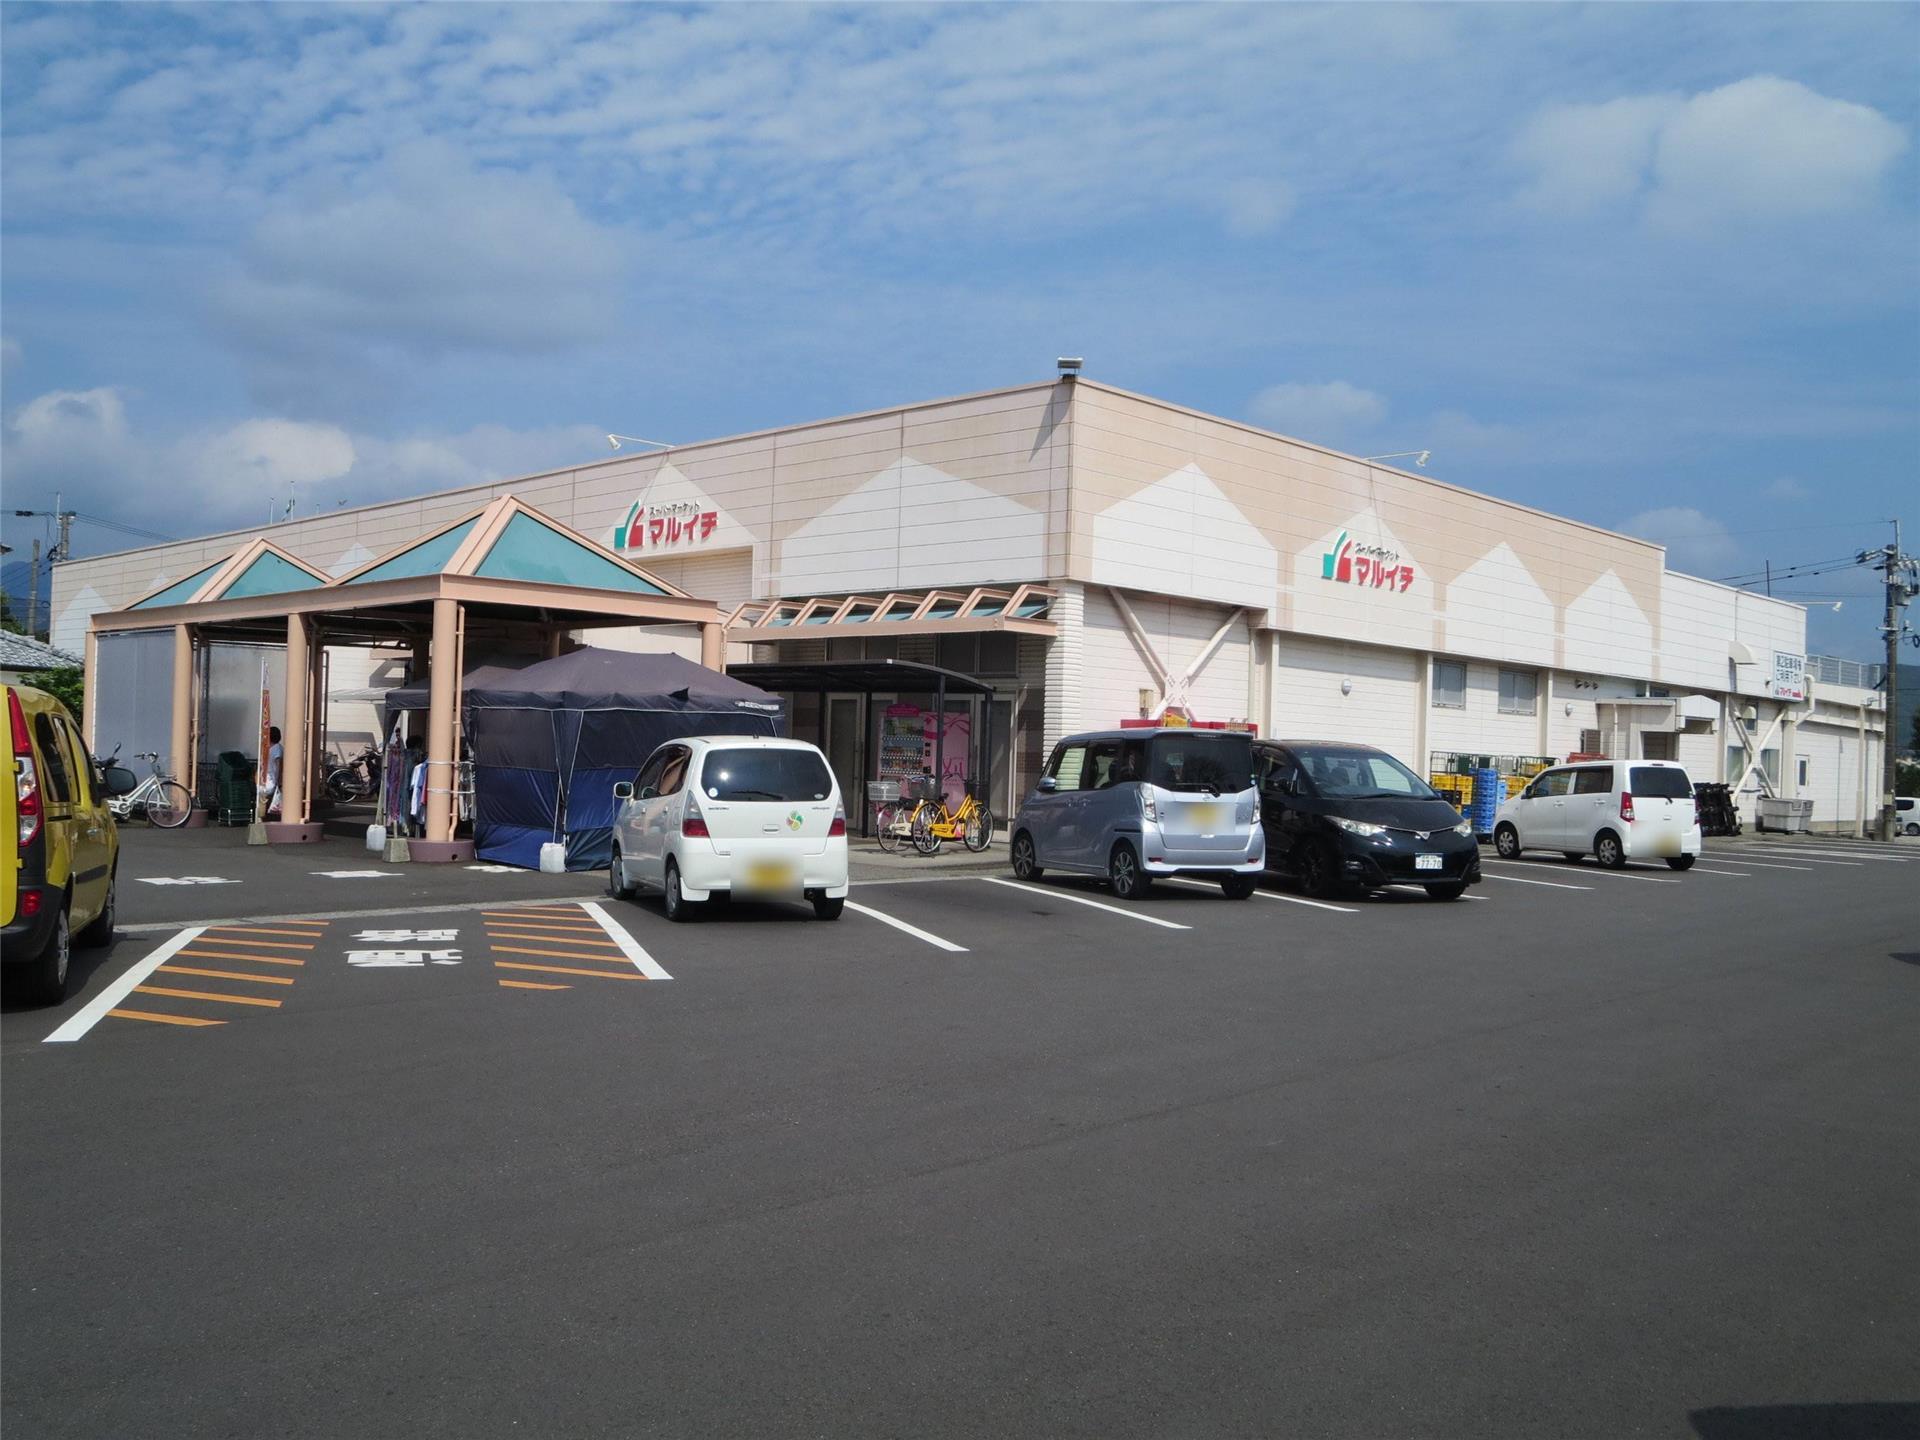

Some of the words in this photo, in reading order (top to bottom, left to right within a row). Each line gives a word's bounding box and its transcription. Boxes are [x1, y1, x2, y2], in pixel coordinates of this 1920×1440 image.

[649, 511, 718, 545] マルイチ
[1355, 556, 1414, 593] マルイチ
